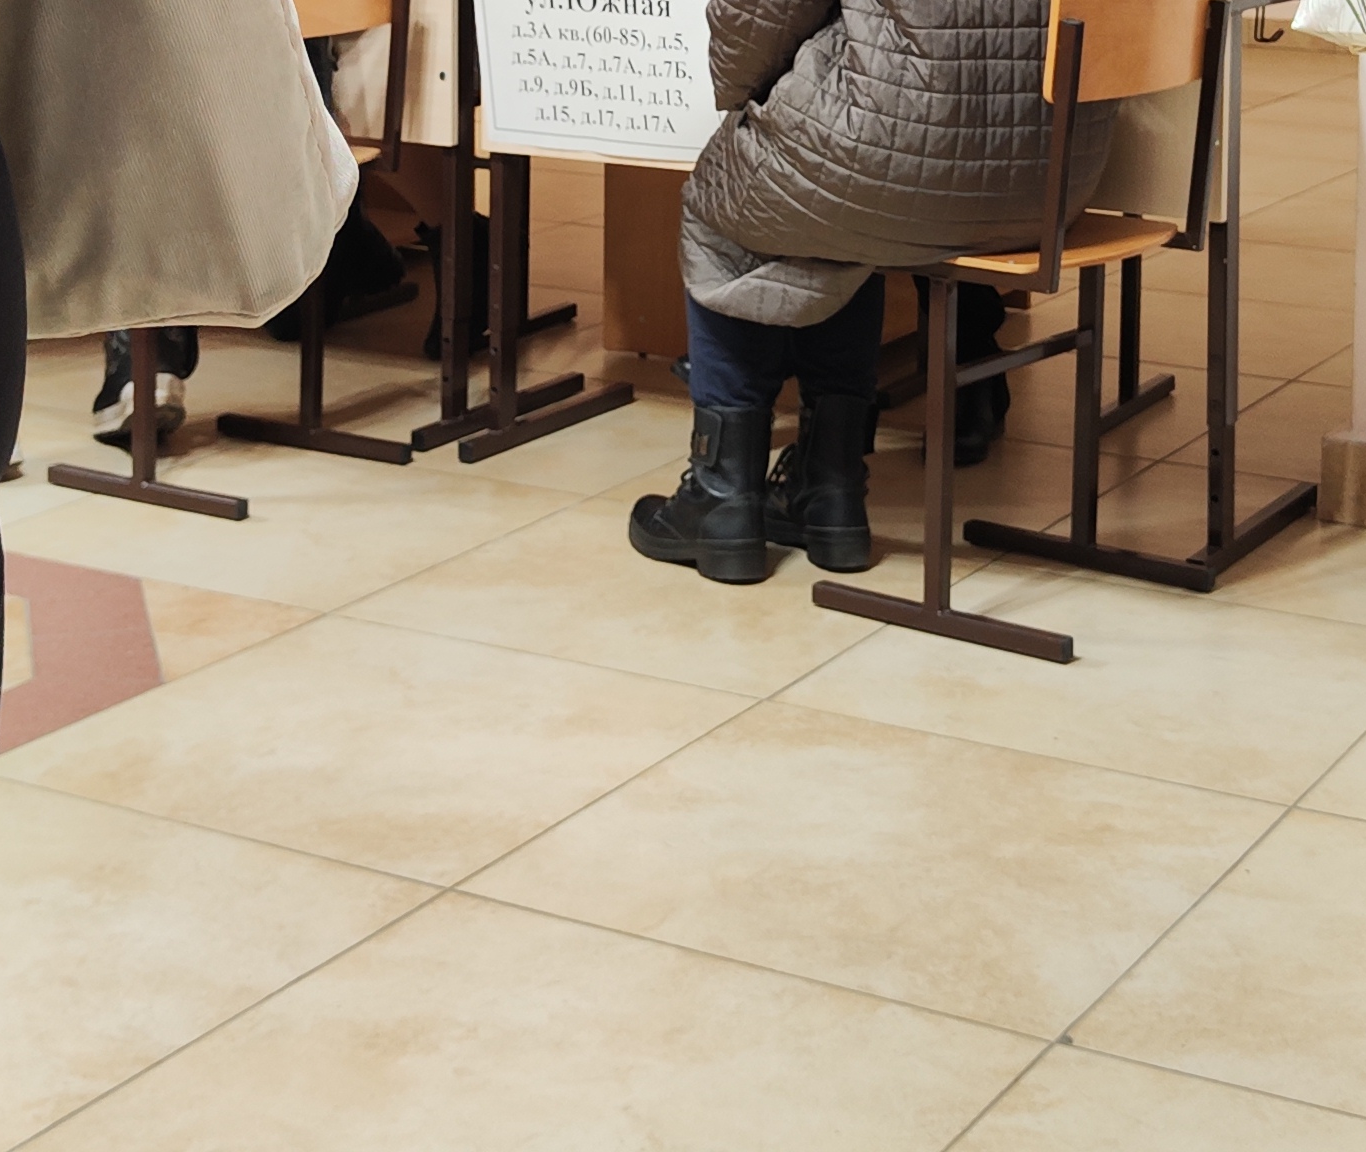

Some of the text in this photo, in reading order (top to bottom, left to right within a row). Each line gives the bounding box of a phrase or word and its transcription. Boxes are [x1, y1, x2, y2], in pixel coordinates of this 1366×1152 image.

[511, 21, 689, 53] д.3А кв.(60-85), д.5,
[511, 48, 693, 84] д.5А, д.7, д.7А, д.7Б,
[518, 76, 690, 111] д.9, д.9Б, д.11, д.13,
[535, 105, 676, 135] д.15, д.17, д.17А
